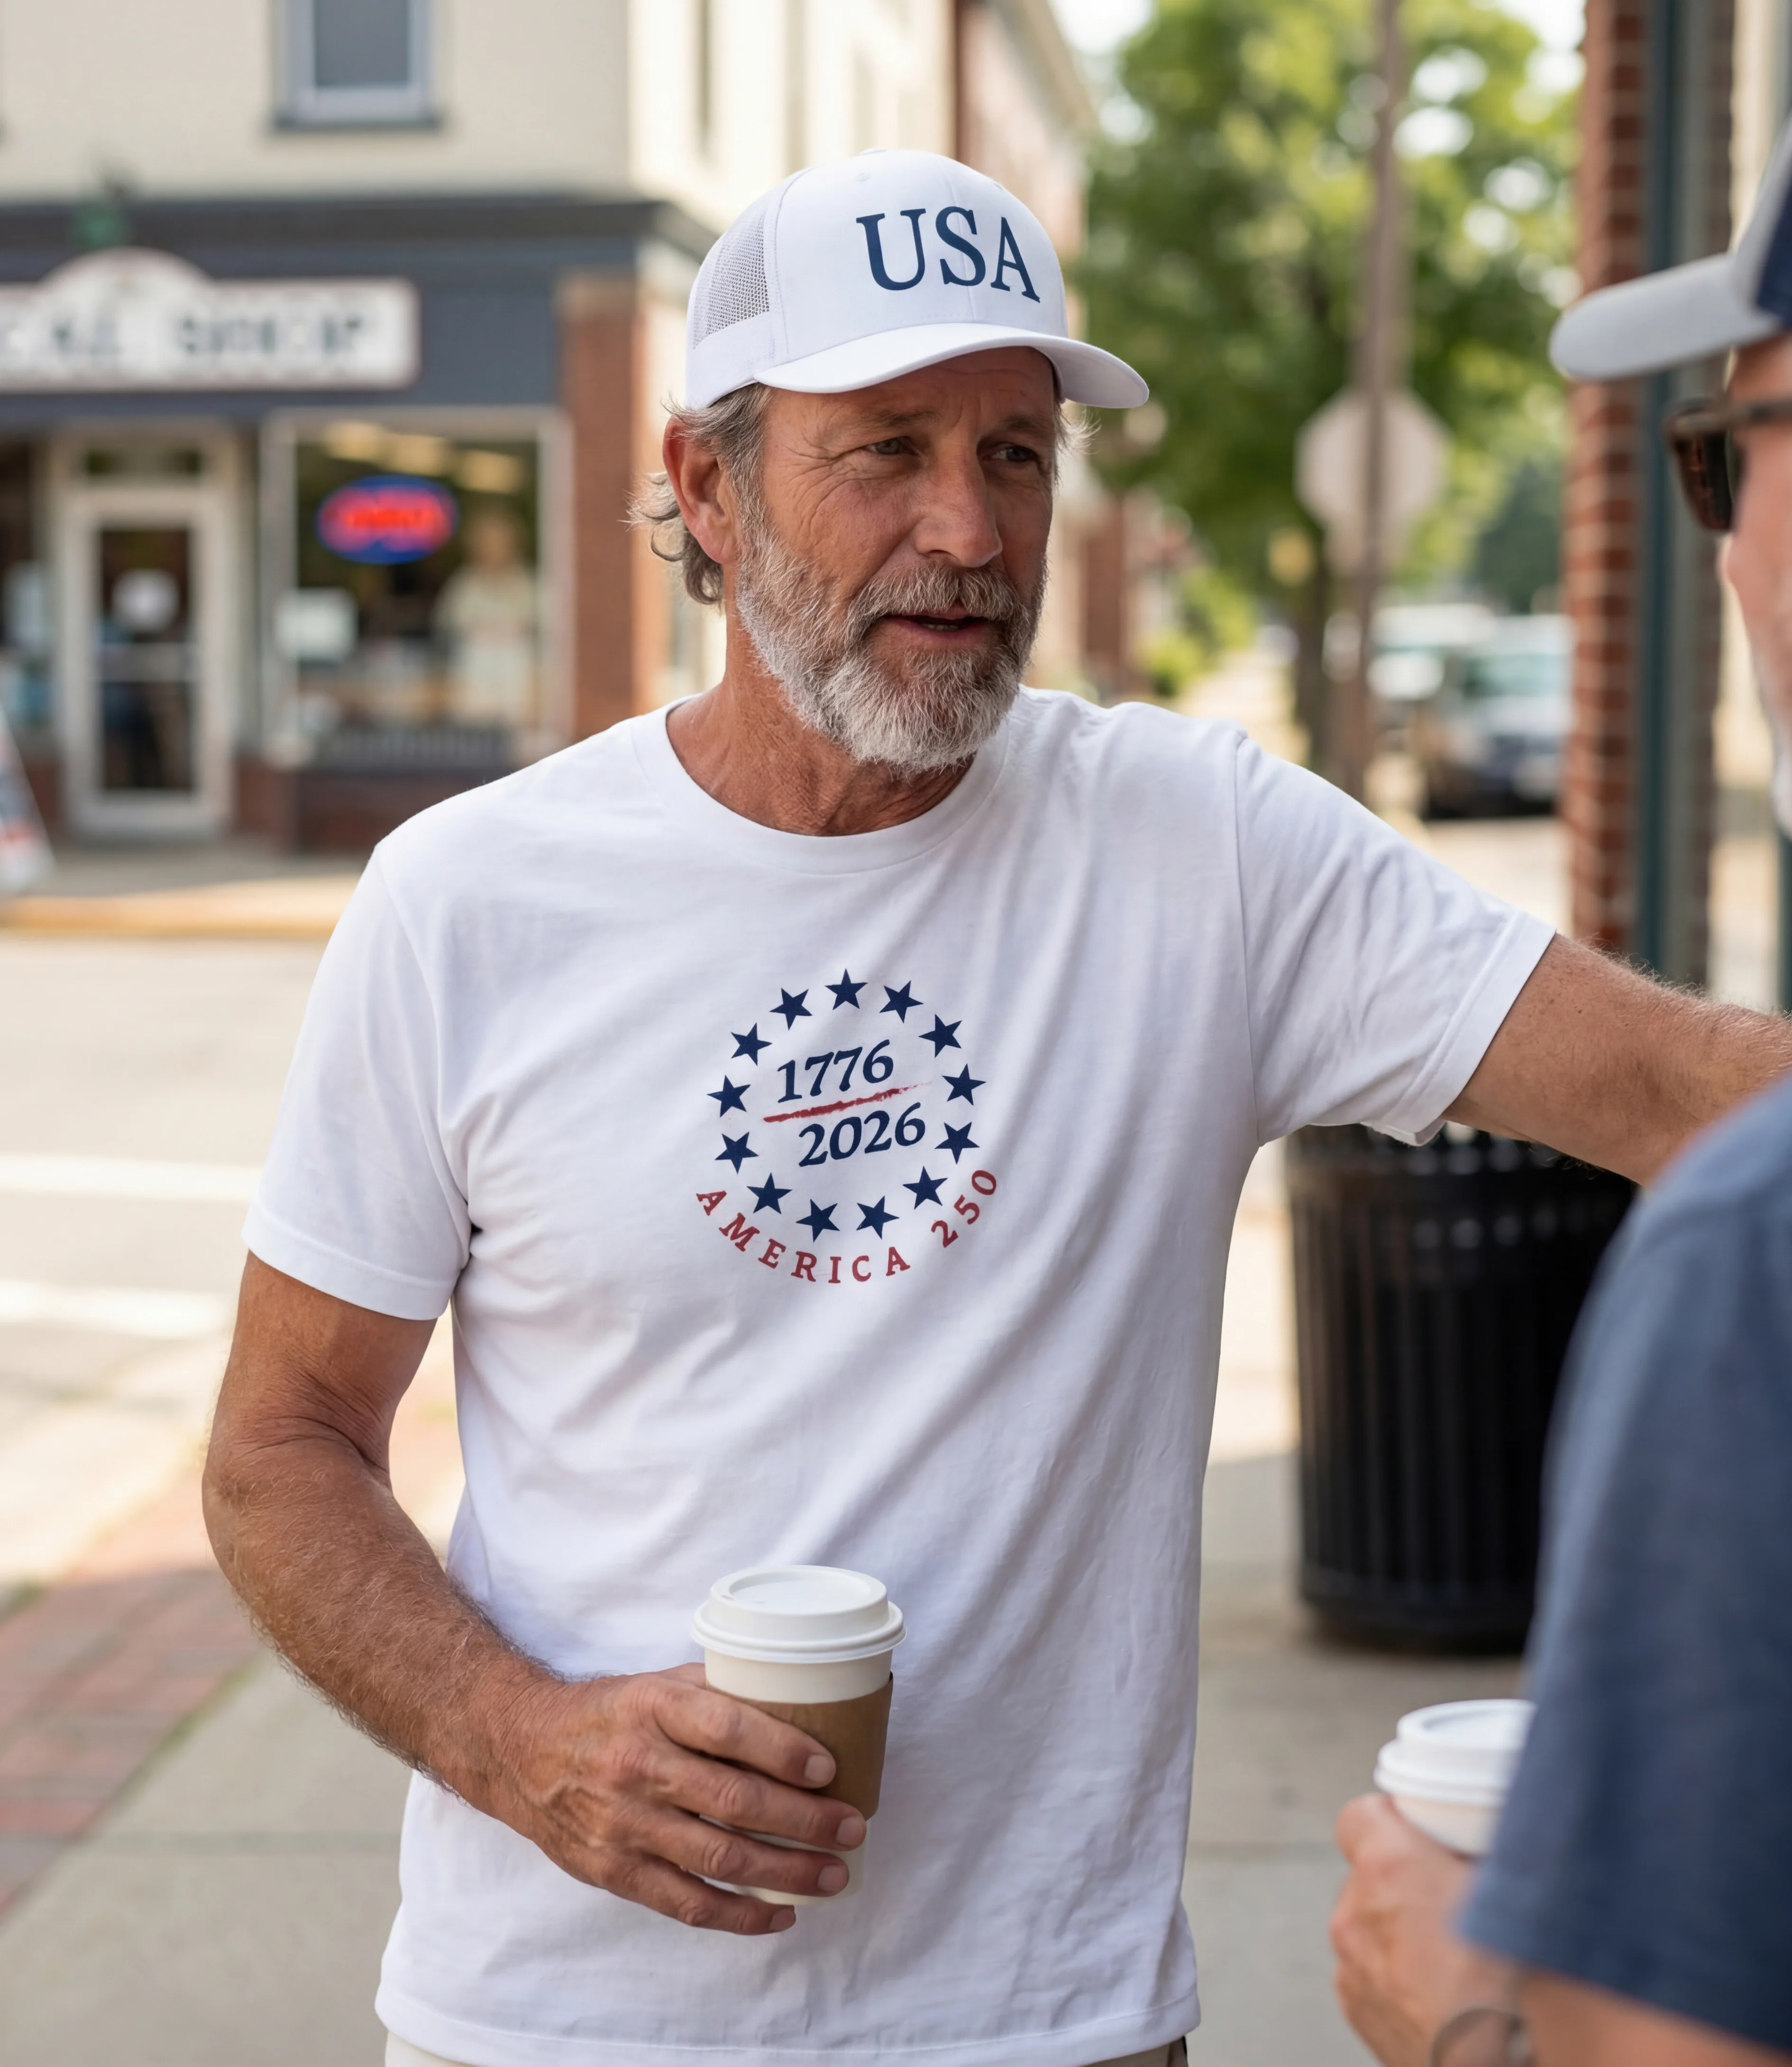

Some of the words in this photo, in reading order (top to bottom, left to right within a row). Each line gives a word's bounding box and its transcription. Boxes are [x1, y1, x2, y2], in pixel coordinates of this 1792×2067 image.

[856, 206, 1041, 303] USA
[777, 1039, 894, 1103] 1776
[798, 1102, 925, 1167] 2026
[695, 1190, 911, 1284] AMERICA
[931, 1170, 997, 1248] 250
